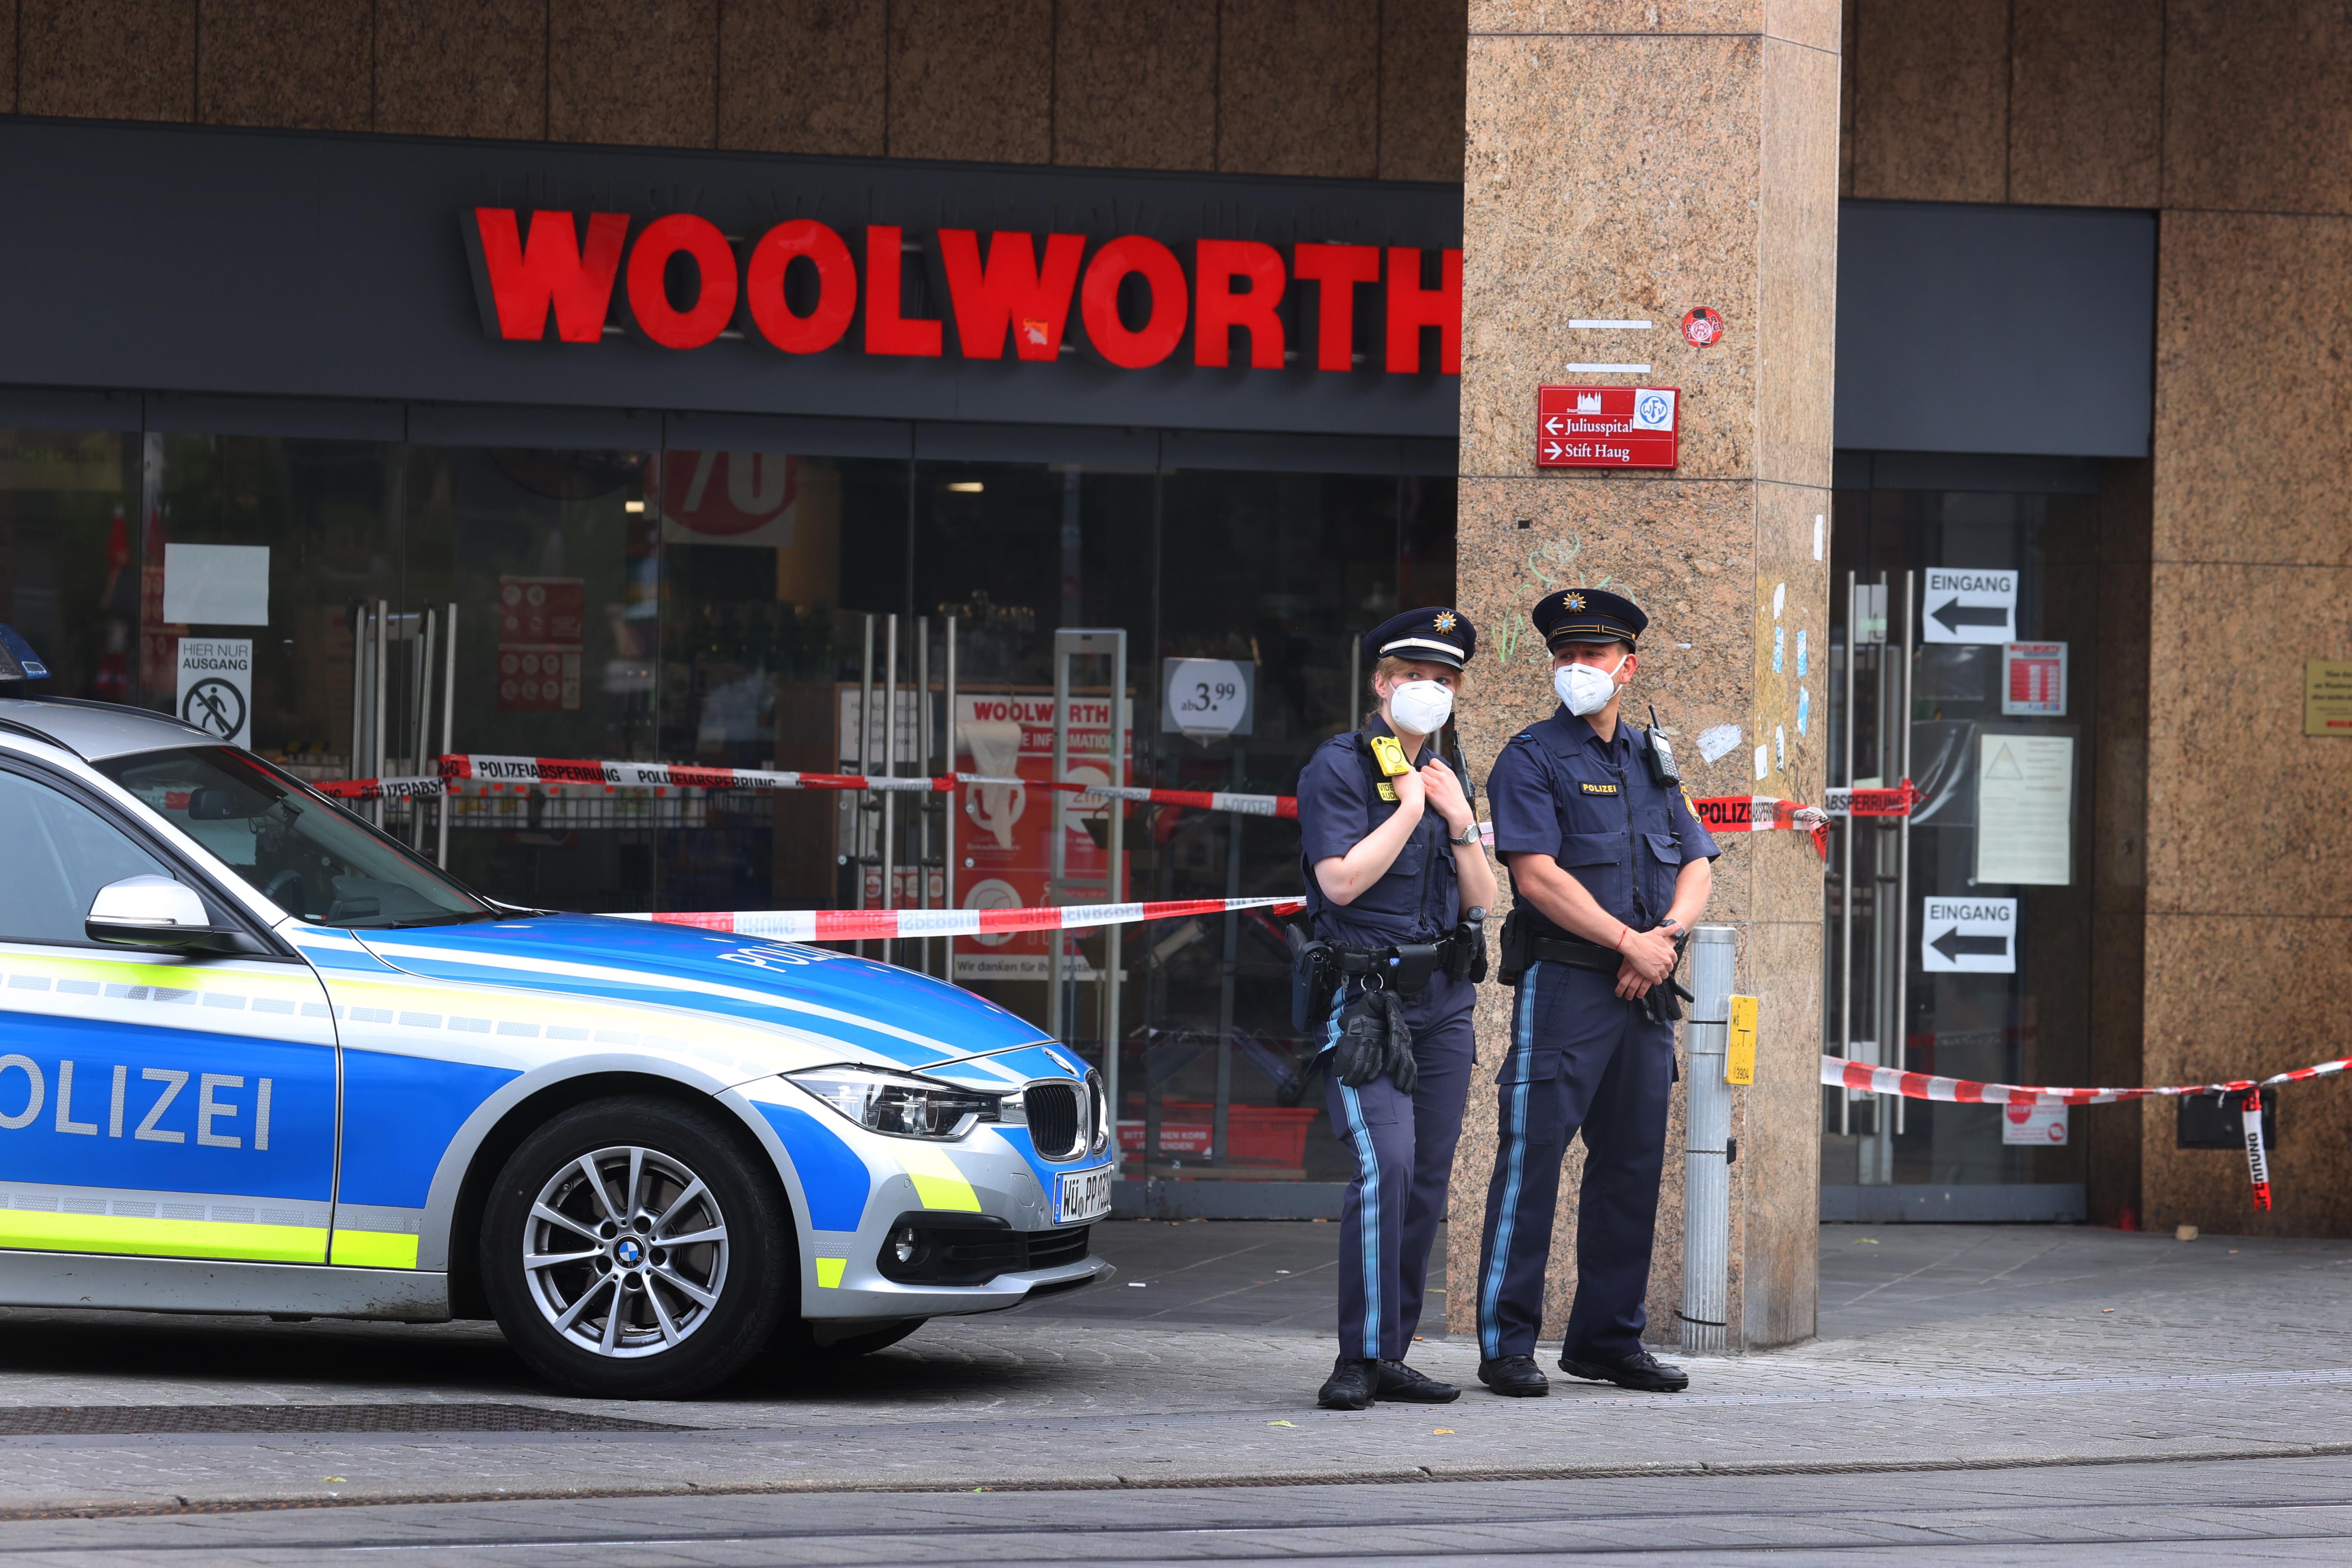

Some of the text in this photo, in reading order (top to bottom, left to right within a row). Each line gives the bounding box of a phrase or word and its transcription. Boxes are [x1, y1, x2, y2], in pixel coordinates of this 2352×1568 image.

[476, 207, 1461, 375] WOOLWORTH
[1643, 400, 1665, 419] WFV
[1565, 418, 1633, 437] Juliusspital
[1565, 443, 1630, 462] Stift Haug
[1931, 575, 2011, 592] EINGANG
[183, 643, 248, 657] HIER NUR
[183, 658, 248, 671] AUSGANG
[1196, 683, 1235, 711] 3.99
[973, 702, 1109, 723] WOOLWRTH
[479, 761, 621, 783] POLIZEIABSPERRUNG
[1583, 784, 1617, 793] POLIZEI
[1930, 904, 2010, 921] EINGANG
[957, 961, 975, 972] Wir
[977, 960, 1017, 972] danken
[1020, 961, 1036, 973] für
[1038, 962, 1049, 973] Ih
[1733, 1014, 1740, 1026] MS
[1736, 1068, 1749, 1080] 3904
[0, 1054, 273, 1151] OLIZEI
[1123, 1131, 1145, 1139] BITT
[1063, 1178, 1079, 1217] WÜ
[1085, 1175, 1096, 1213] PP
[617, 1255, 643, 1267] BMW
